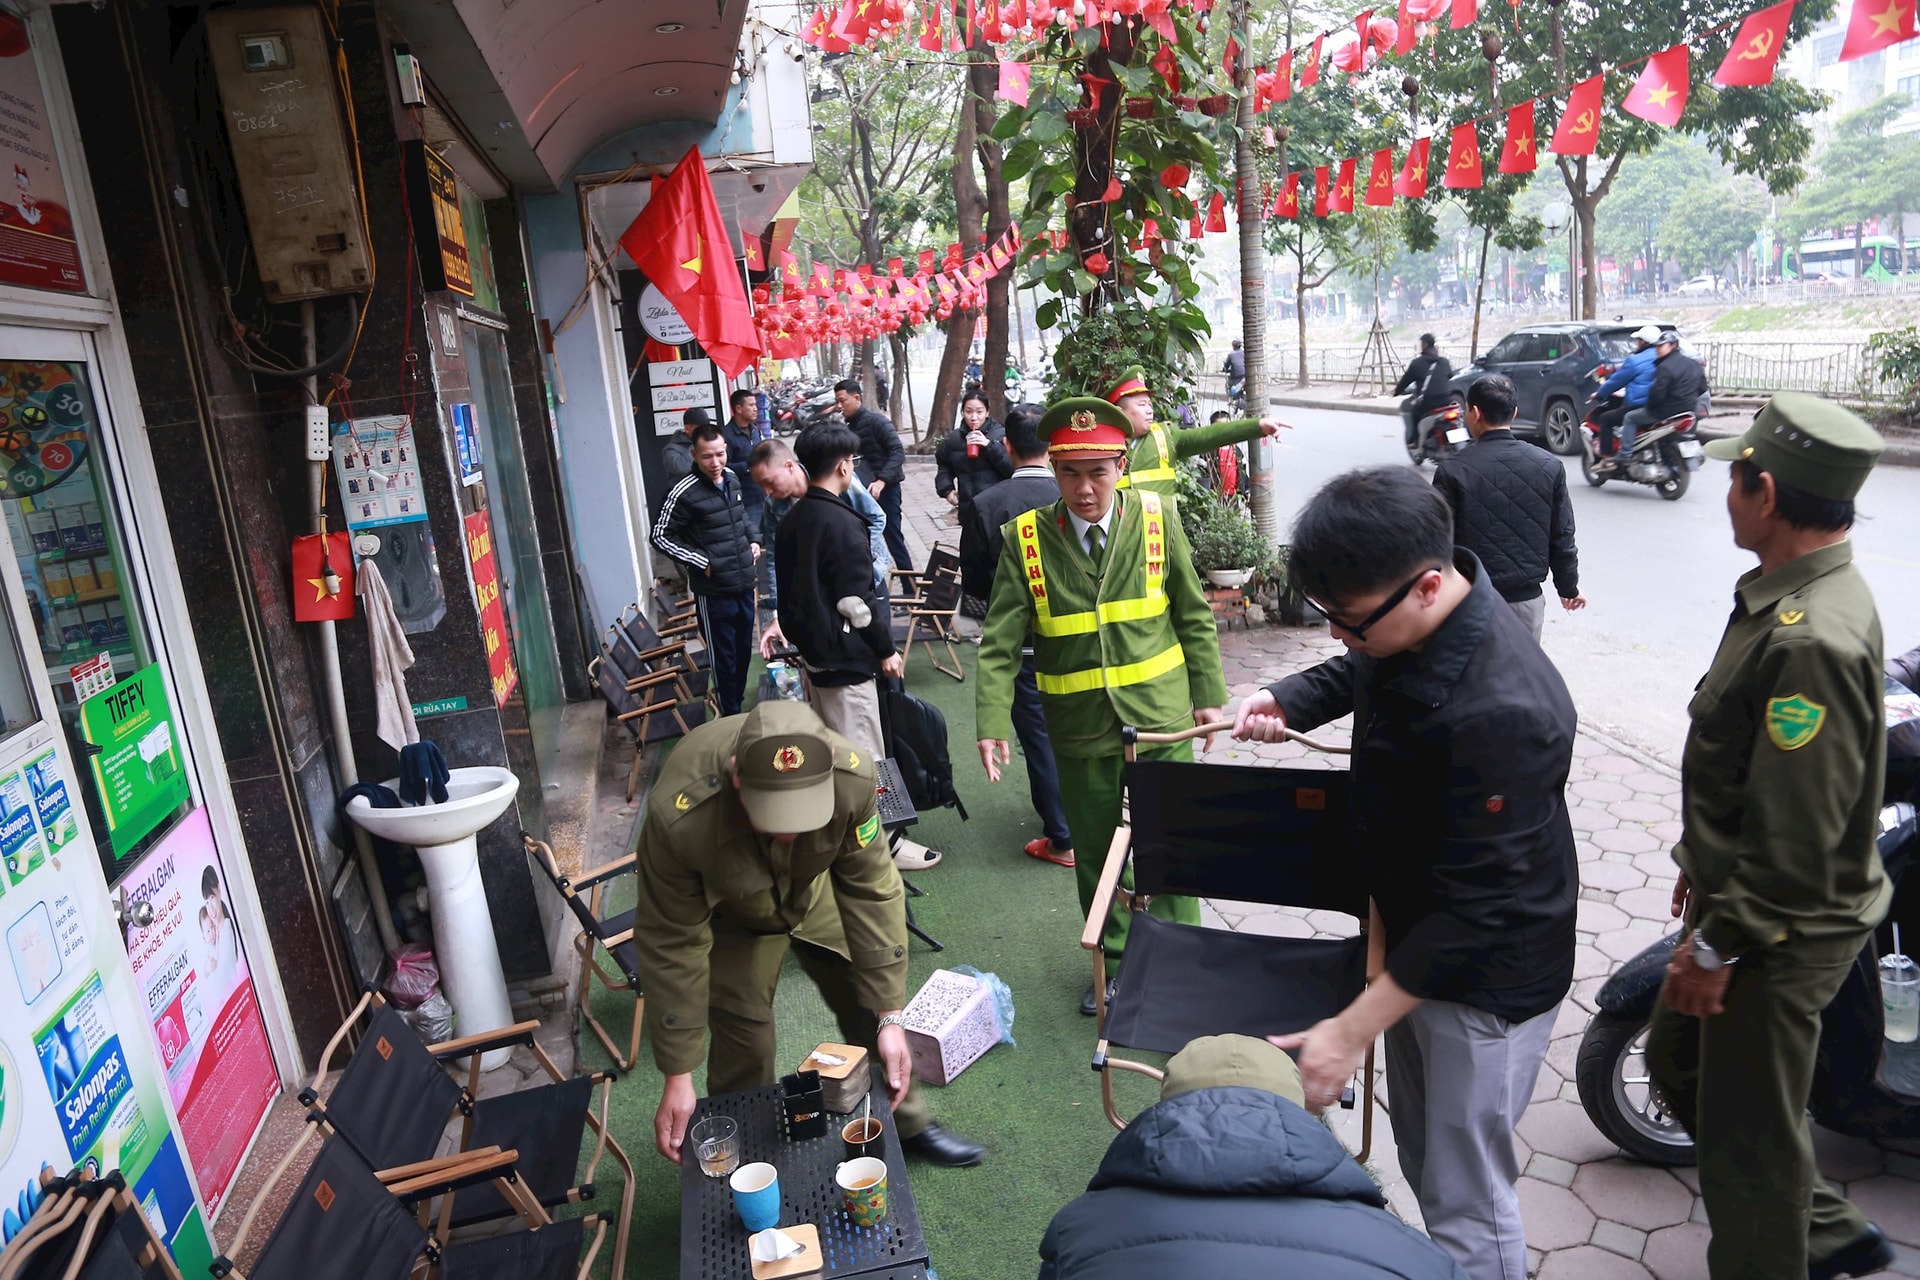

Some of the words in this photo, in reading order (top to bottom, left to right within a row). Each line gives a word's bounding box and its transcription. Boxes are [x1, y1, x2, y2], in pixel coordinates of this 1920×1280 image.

[666, 366, 693, 377] Nail
[56, 393, 84, 416] 30
[48, 449, 65, 464] 70
[14, 471, 37, 488] 60
[1146, 501, 1161, 576] CAHN
[1021, 524, 1046, 598] CAHN
[104, 679, 146, 725] TIFFY
[441, 701, 457, 711] TAY
[38, 787, 65, 813] Salonpas
[0, 811, 30, 841] Salonpas
[148, 950, 189, 1008] EFFERALGAN
[37, 1043, 45, 1058] 3
[65, 1051, 120, 1130] Salonpas
[72, 1125, 90, 1151] Pain
[89, 1097, 110, 1127] Relief
[109, 1073, 128, 1100] Patch
